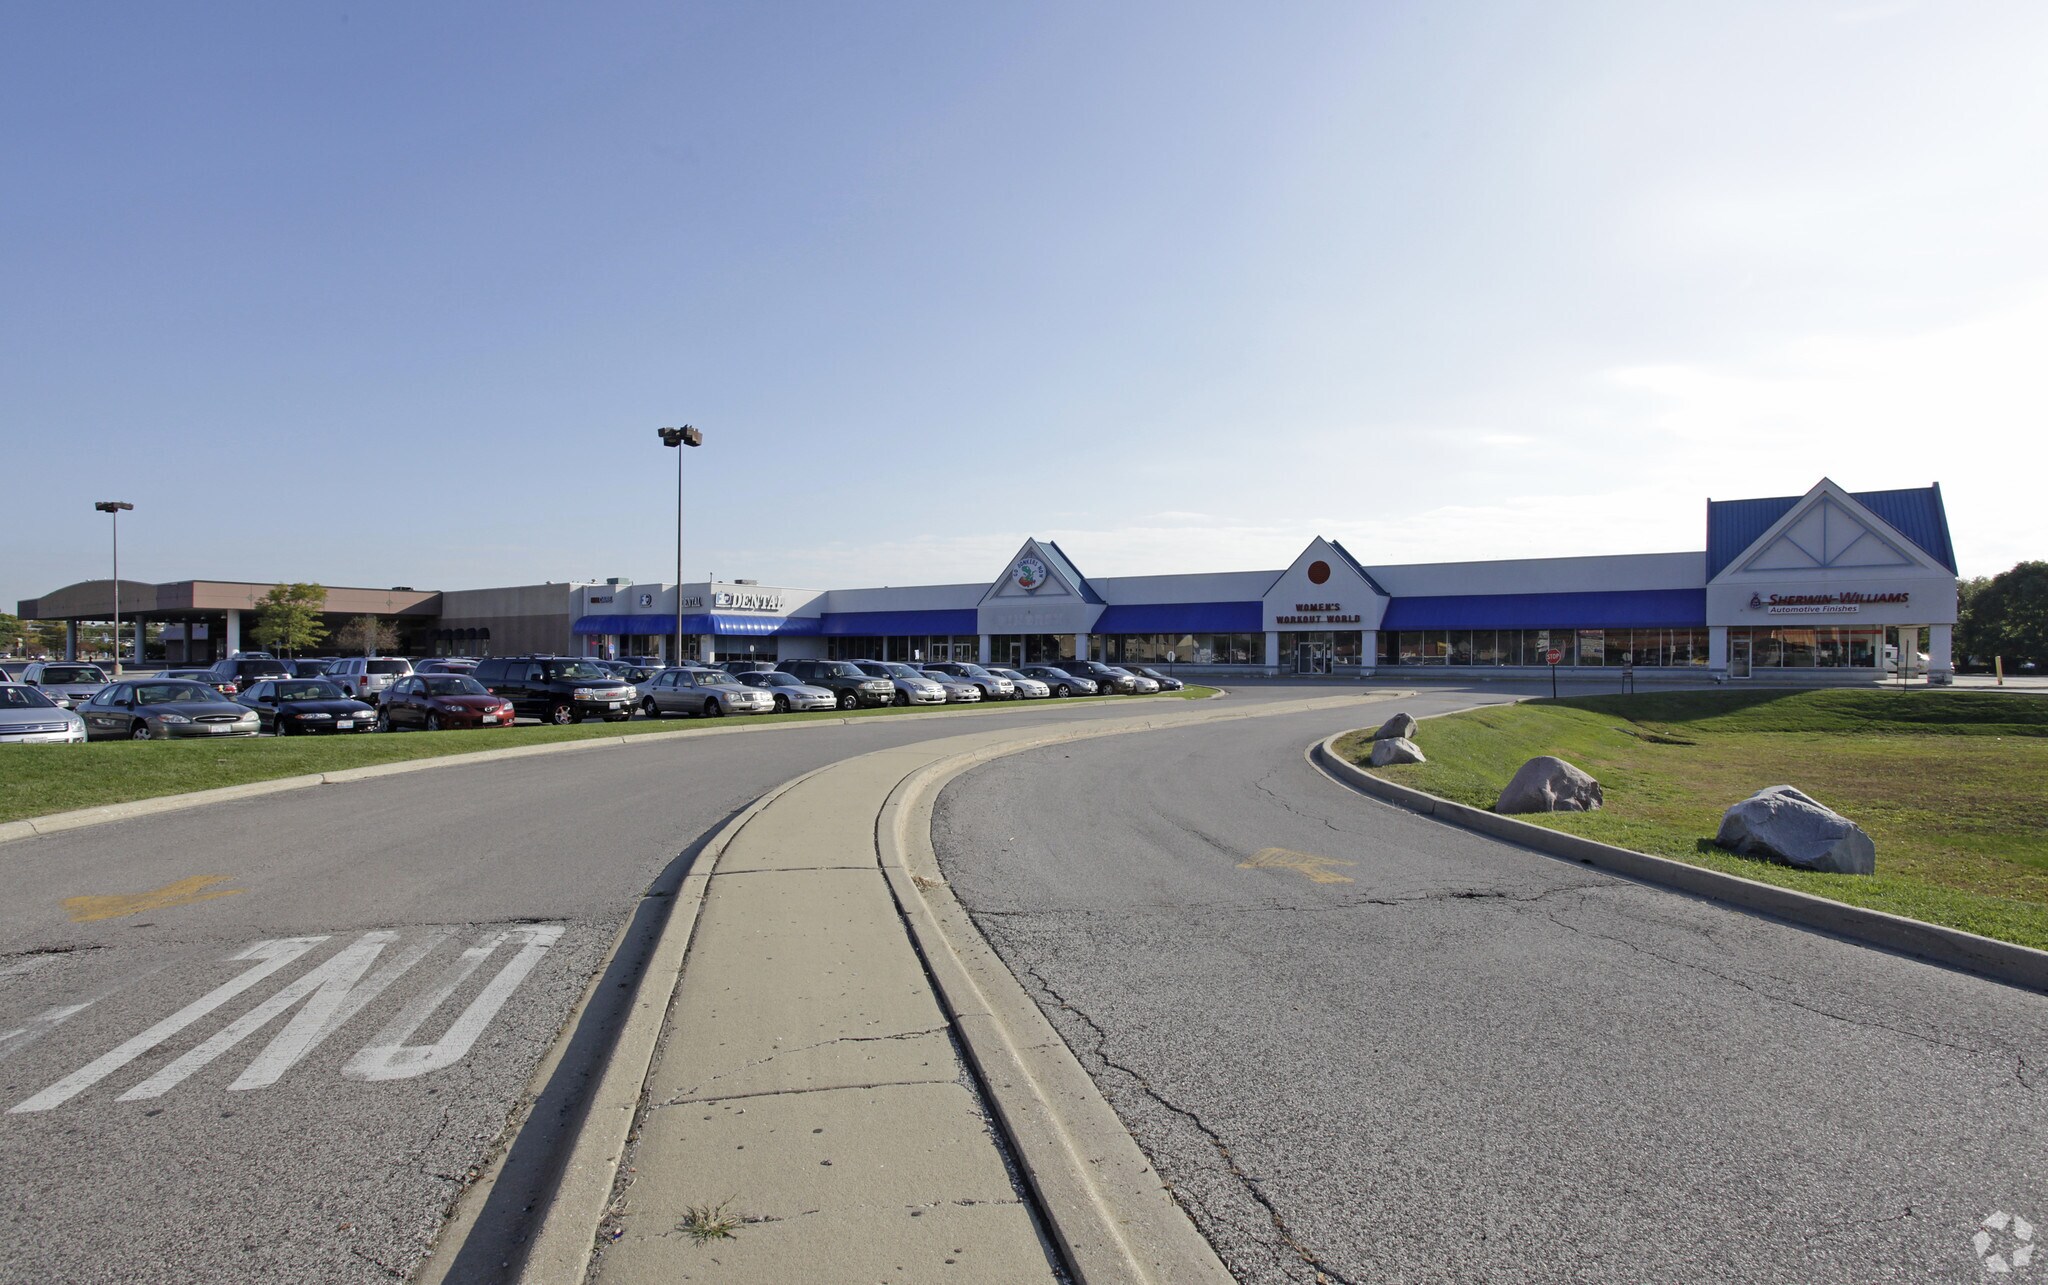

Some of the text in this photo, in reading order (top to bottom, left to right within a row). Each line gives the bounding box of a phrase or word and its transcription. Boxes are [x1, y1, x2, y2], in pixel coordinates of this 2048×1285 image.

[732, 592, 784, 610] DENTAL
[1769, 592, 1910, 606] SHERWIN-WILLIAMS
[1296, 603, 1341, 612] WOMEN'S
[1770, 605, 1858, 614] Automotive Finishes
[1276, 614, 1361, 624] WORKOUT WORLD
[1546, 652, 1560, 660] STOP
